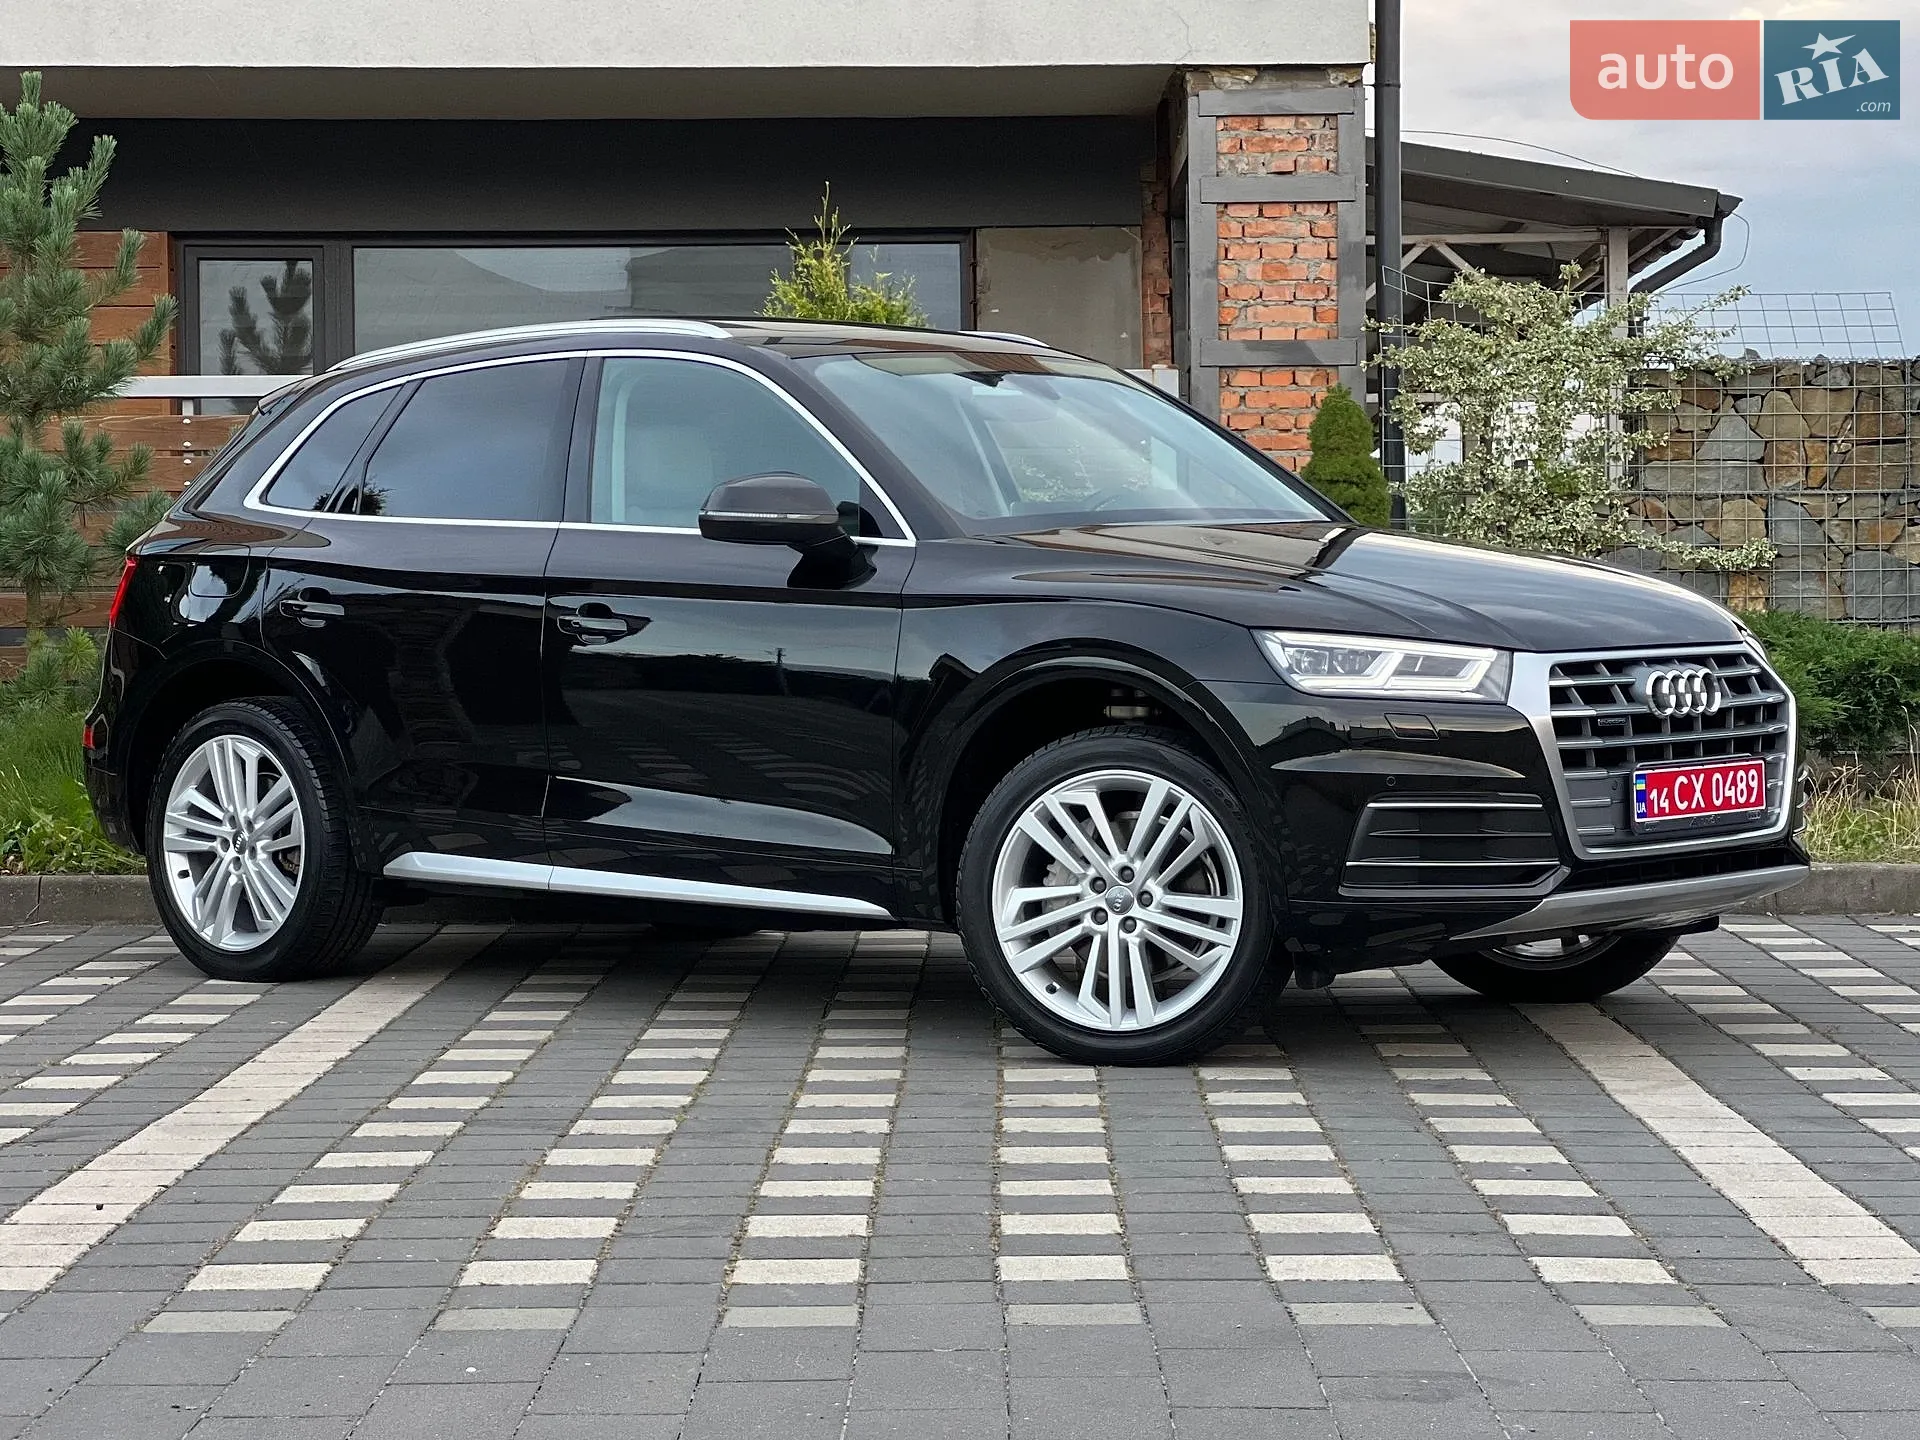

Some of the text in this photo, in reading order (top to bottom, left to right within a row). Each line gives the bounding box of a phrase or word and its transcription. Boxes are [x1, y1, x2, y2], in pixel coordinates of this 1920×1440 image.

[1650, 768, 1758, 814] 14 CX 0489
[1636, 801, 1647, 813] UA
